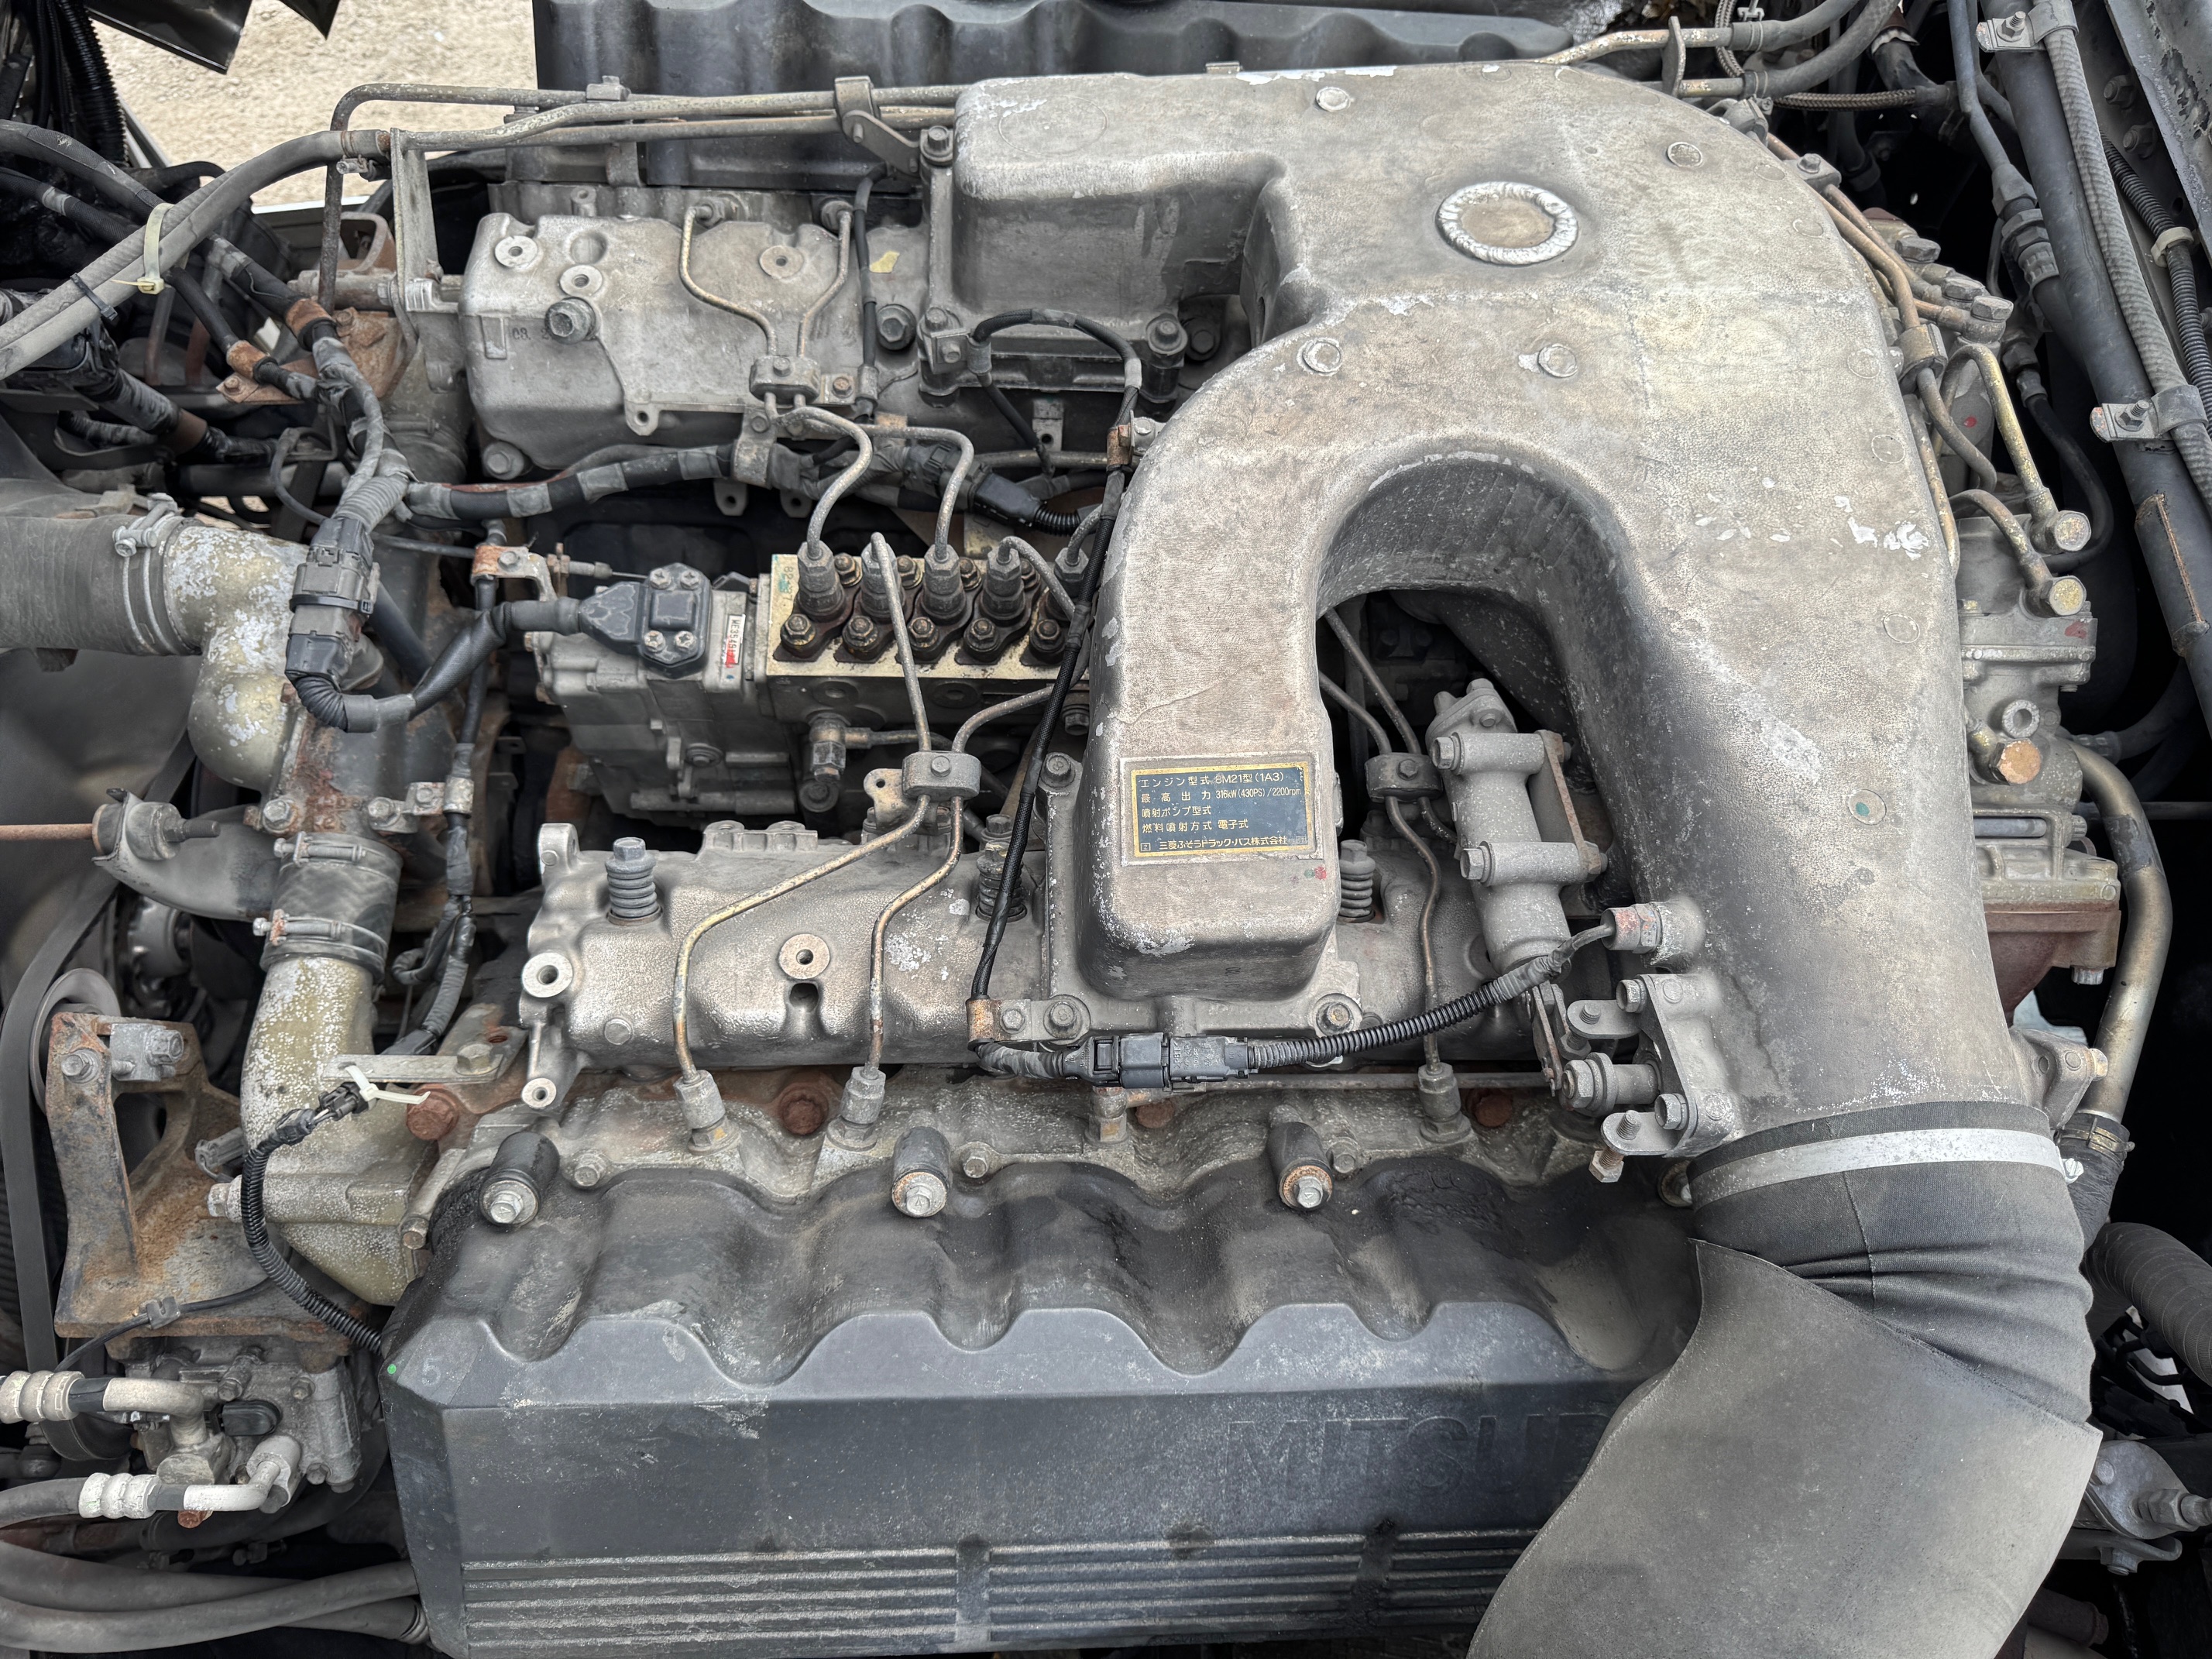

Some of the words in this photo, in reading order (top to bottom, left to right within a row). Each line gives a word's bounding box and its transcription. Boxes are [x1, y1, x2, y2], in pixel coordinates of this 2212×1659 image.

[1140, 775, 1210, 788] エンジン型式
[1141, 790, 1211, 803] 最高出力
[1141, 805, 1211, 819] 噴射ポンプ型式
[1142, 820, 1212, 833] 燃料噴射方式
[1218, 818, 1249, 830] 電子式
[421, 1355, 444, 1386] 5
